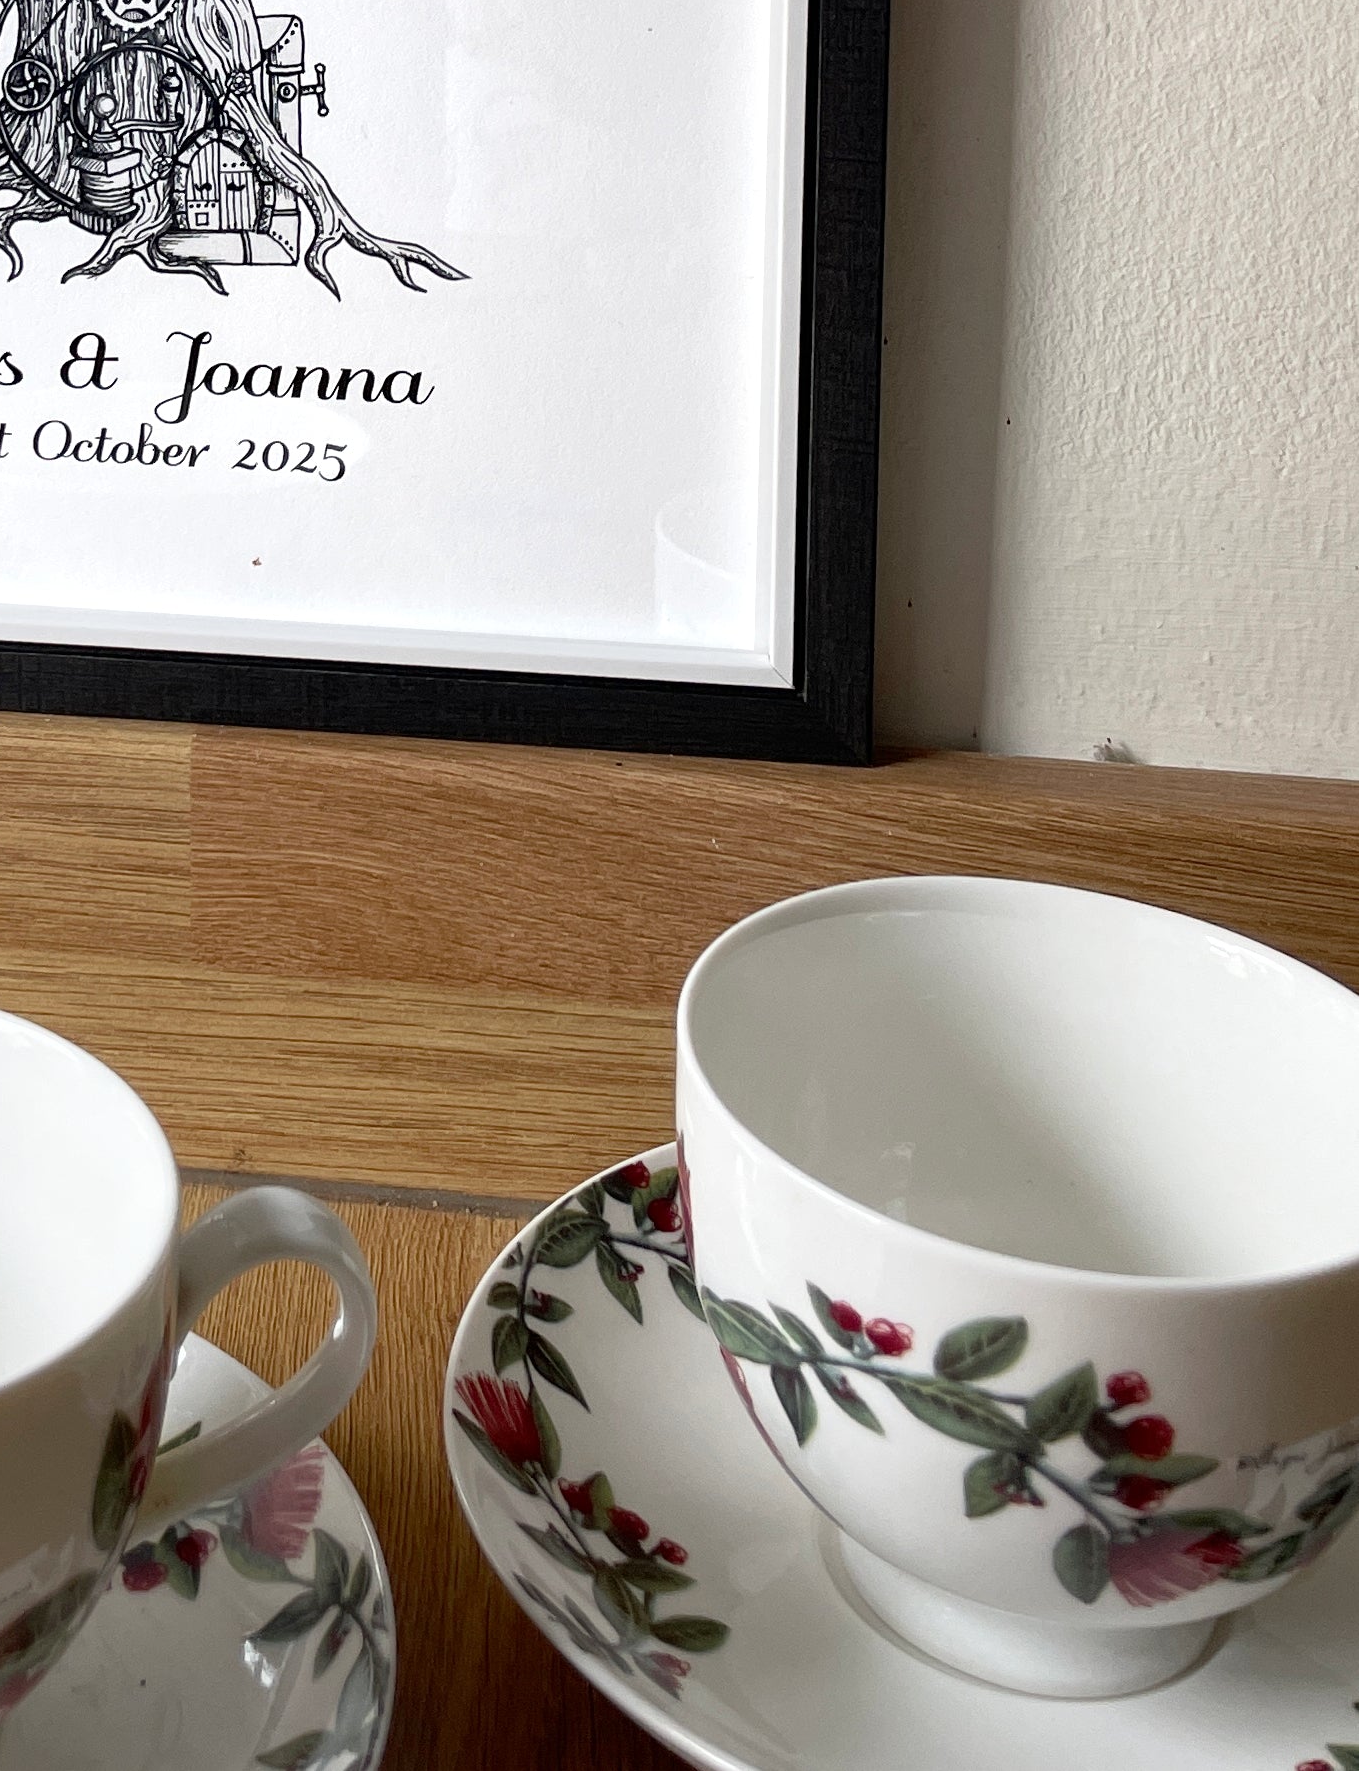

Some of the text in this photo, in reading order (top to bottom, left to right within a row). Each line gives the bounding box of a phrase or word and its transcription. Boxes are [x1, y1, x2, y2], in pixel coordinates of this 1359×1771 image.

[59, 332, 119, 390] &
[154, 331, 435, 425] Joanna
[32, 420, 210, 468] October
[232, 440, 349, 482] 2025
